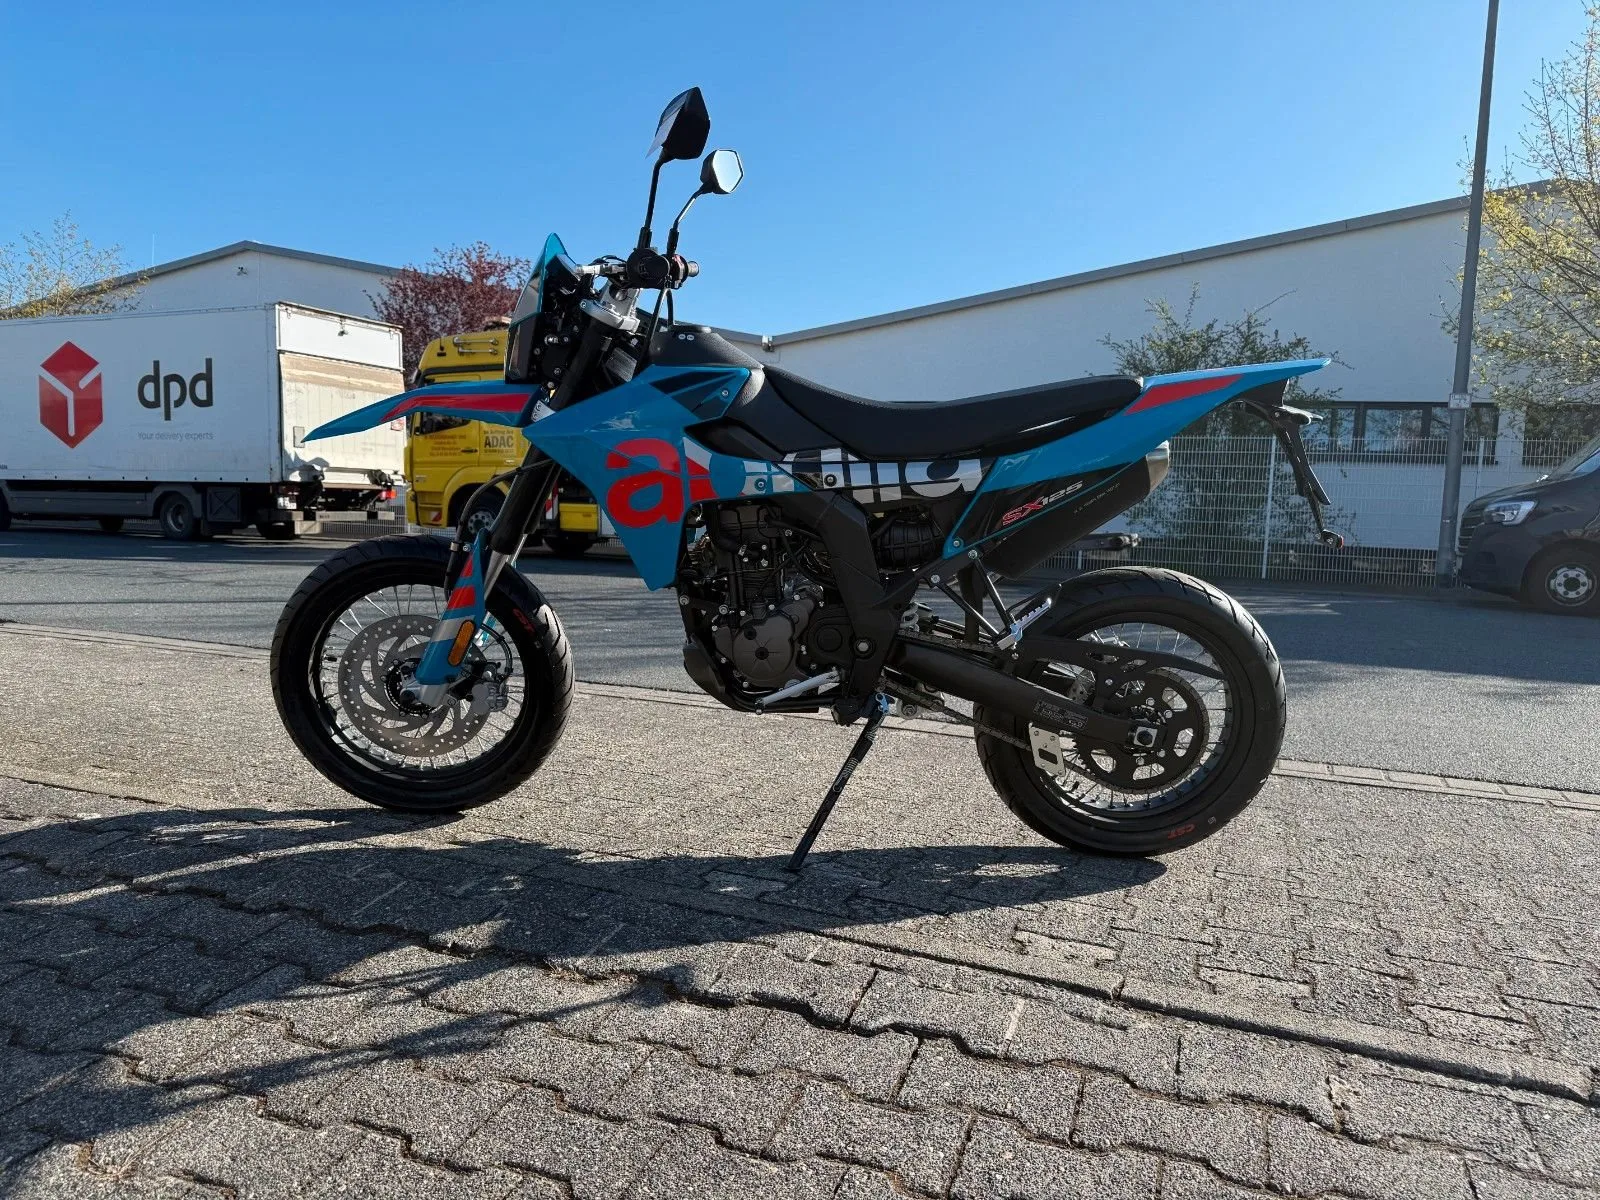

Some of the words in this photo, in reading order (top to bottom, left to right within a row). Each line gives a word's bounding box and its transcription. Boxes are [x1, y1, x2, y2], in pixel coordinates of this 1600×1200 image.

[137, 358, 213, 421] dpd
[138, 432, 154, 440] Your
[155, 431, 184, 442] delivery
[484, 435, 514, 449] ADAC
[1167, 824, 1195, 840] CST
